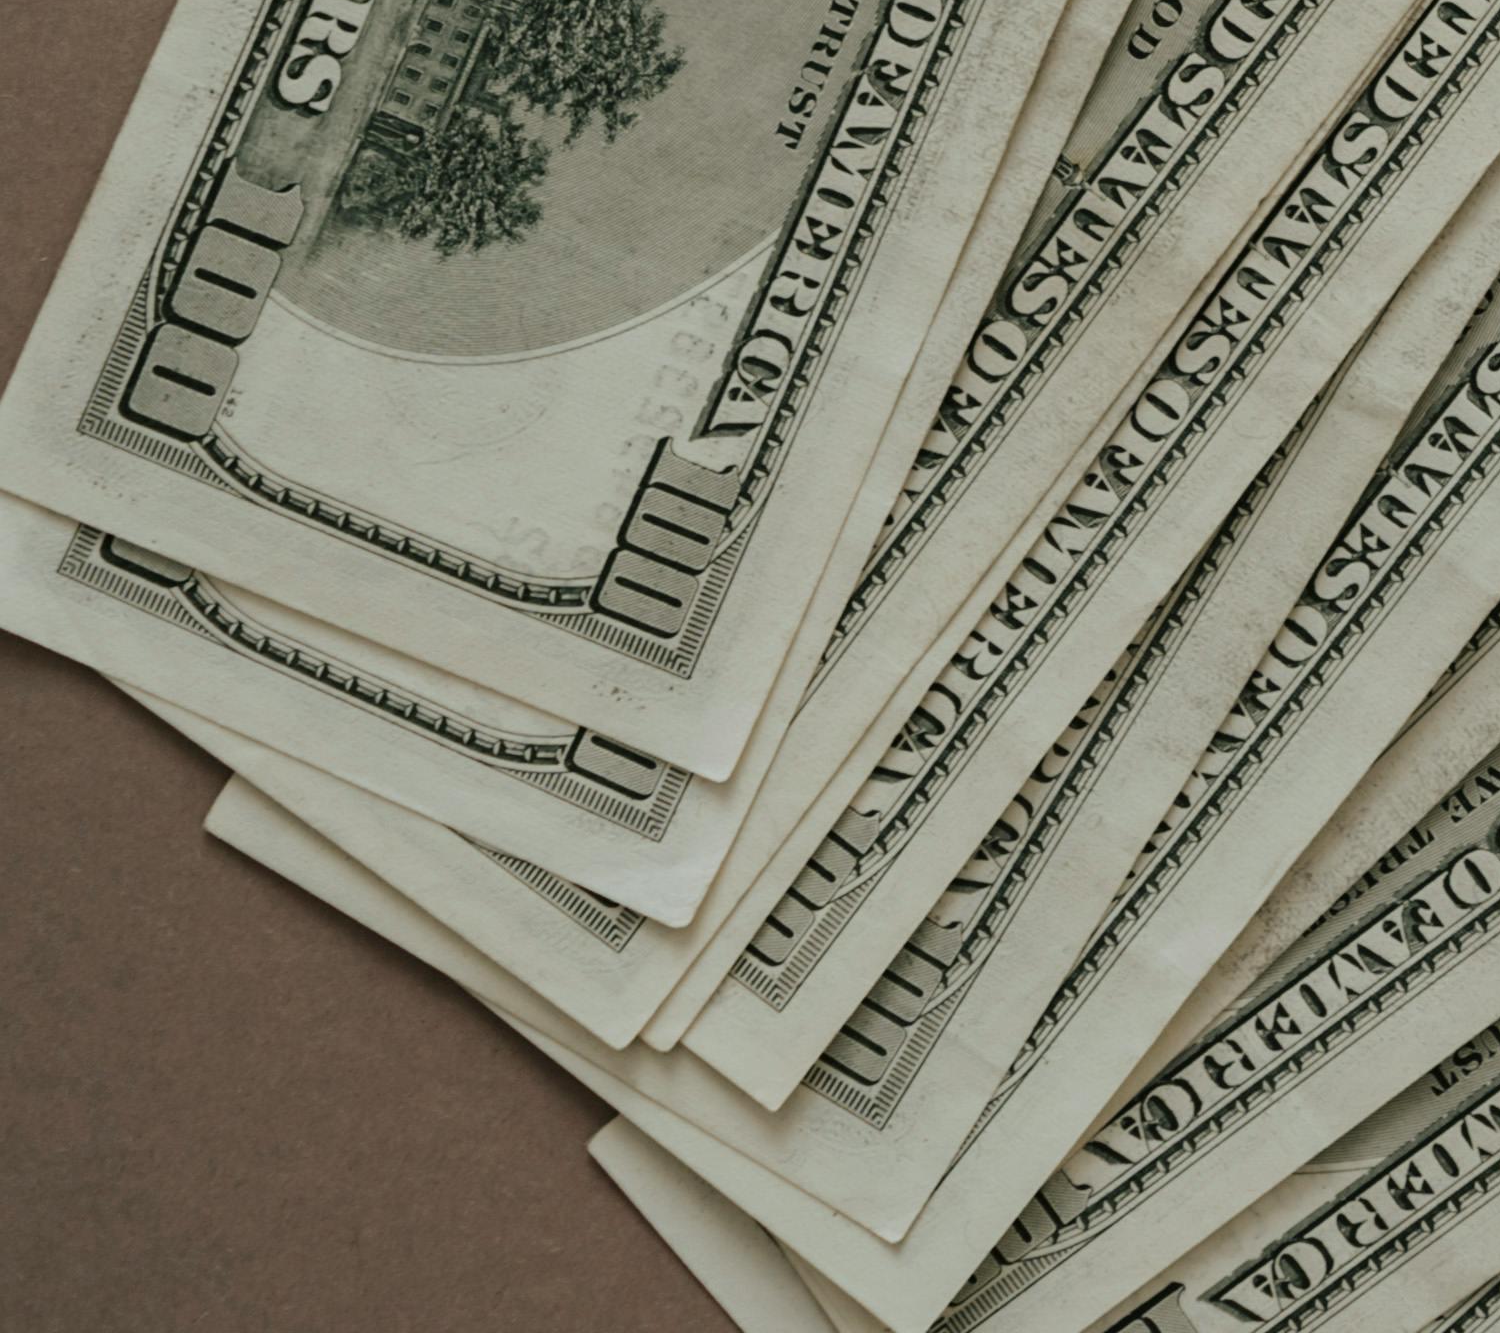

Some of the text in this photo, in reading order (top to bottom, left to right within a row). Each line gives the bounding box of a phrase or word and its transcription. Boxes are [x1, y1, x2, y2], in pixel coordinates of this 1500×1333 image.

[113, 153, 312, 452] 100
[695, 67, 908, 466] AMERICA
[994, 39, 1231, 342] STATES
[1160, 105, 1394, 398] STATES
[585, 434, 748, 646] 100
[1076, 899, 1431, 1190] AMERICA
